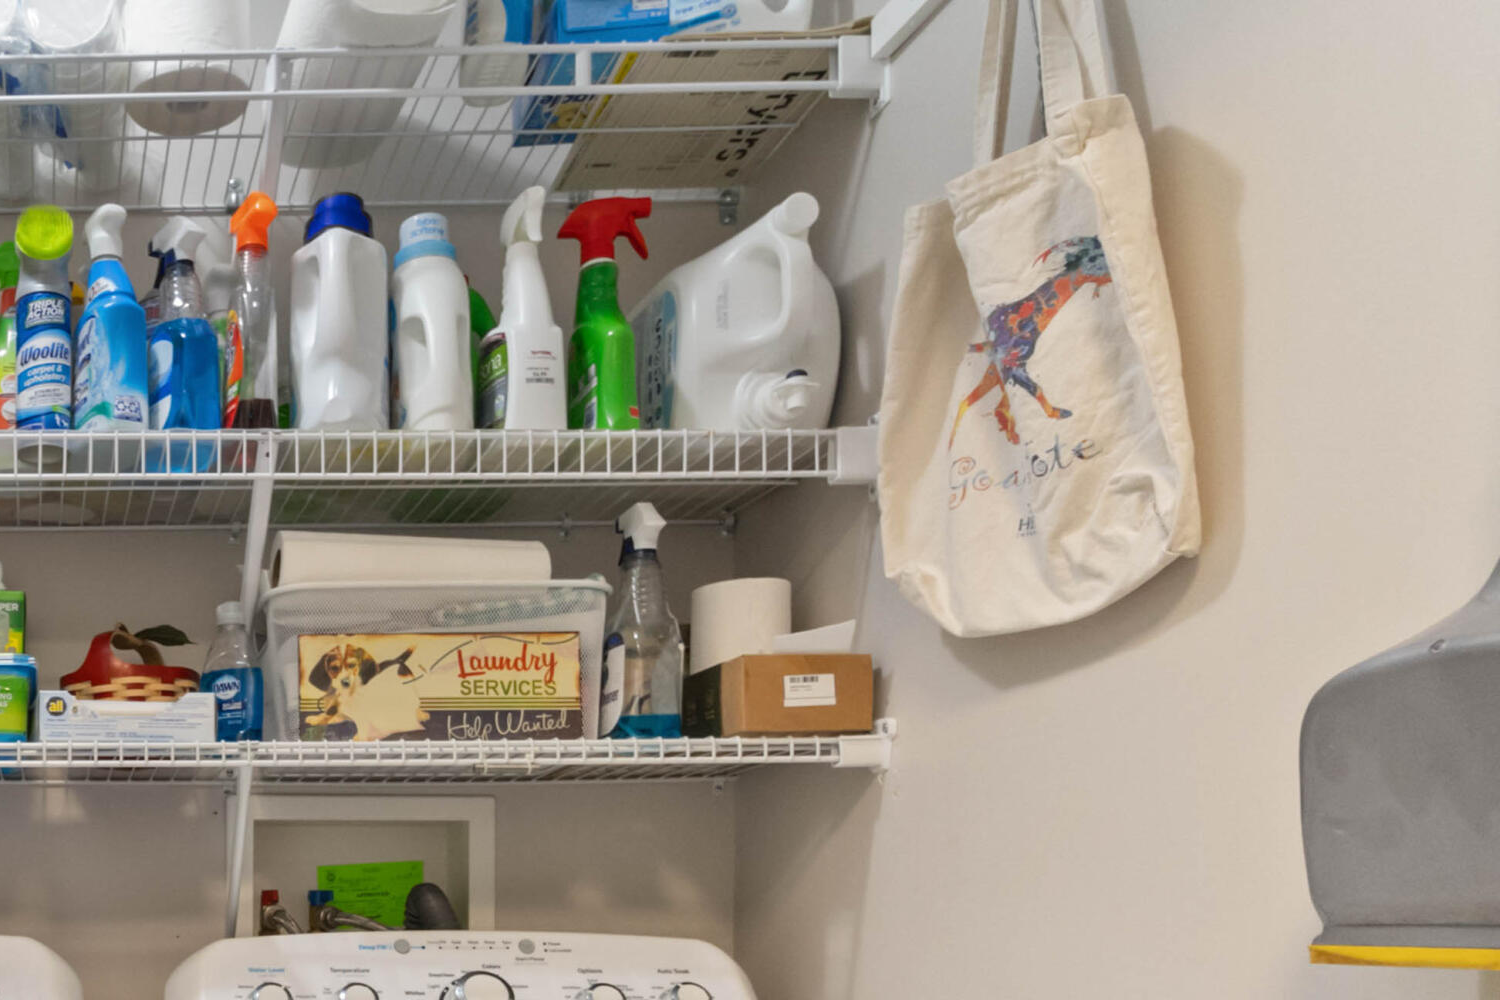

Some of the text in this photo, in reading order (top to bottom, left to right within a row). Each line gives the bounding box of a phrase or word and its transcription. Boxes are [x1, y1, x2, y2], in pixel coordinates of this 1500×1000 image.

[29, 299, 64, 311] TRIPLE
[27, 308, 65, 320] ACTION
[20, 341, 70, 367] Woolite
[457, 643, 557, 684] Laundry
[214, 682, 240, 692] DAWN
[460, 680, 557, 696] SERVICES
[49, 700, 64, 712] all
[447, 708, 570, 740] Help Wanted
